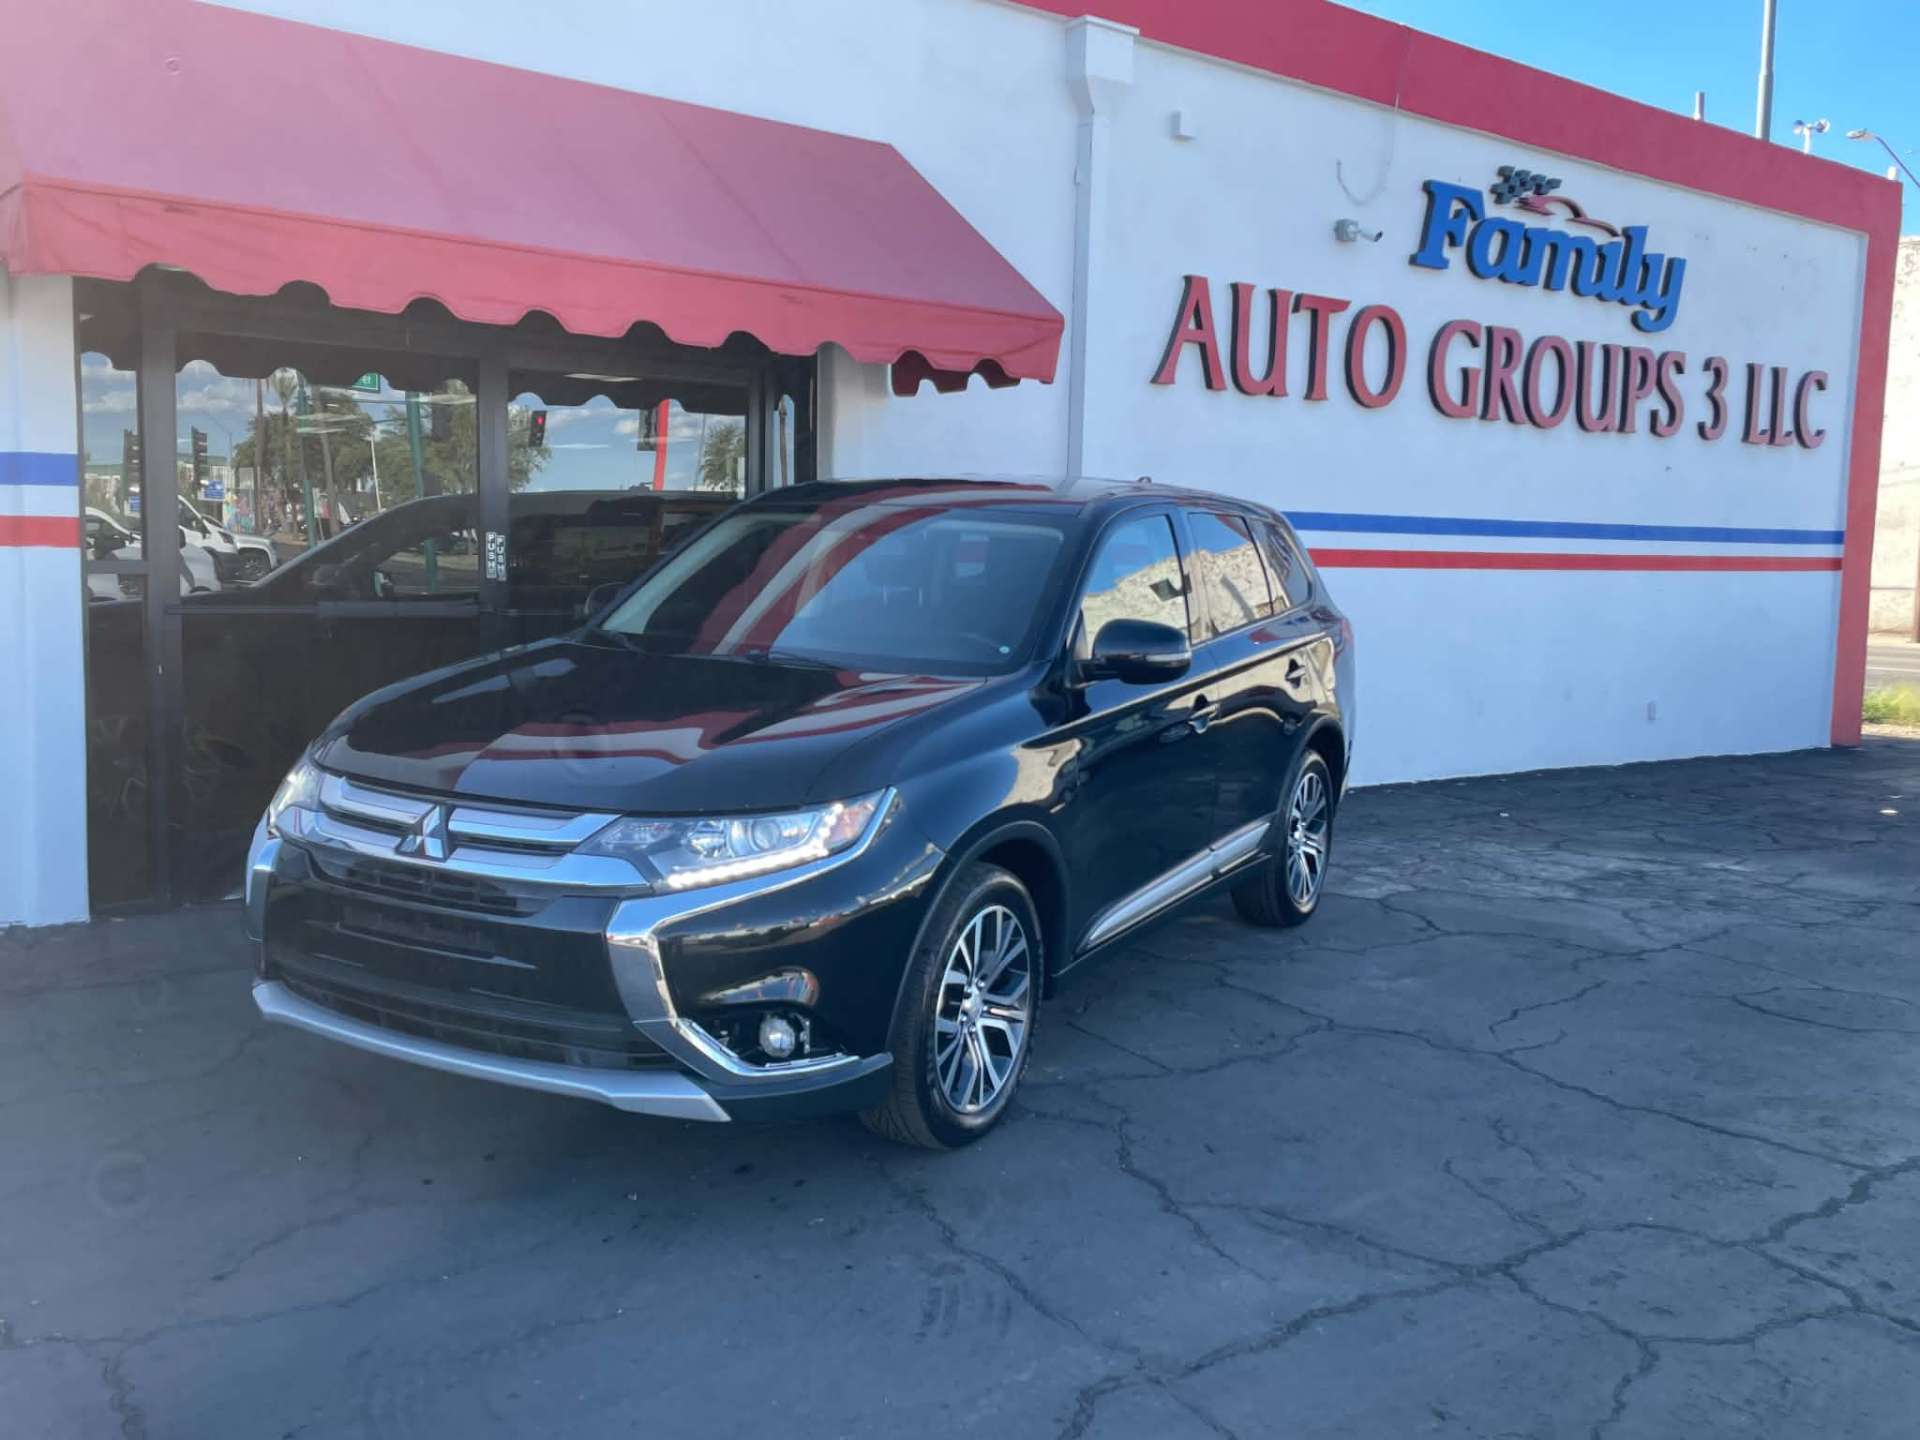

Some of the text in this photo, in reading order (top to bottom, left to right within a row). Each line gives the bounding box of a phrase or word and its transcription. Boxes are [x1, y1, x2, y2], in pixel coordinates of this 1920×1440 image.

[1409, 179, 1686, 332] Family
[1150, 274, 1829, 449] AUTO GROUPS 3 LLC
